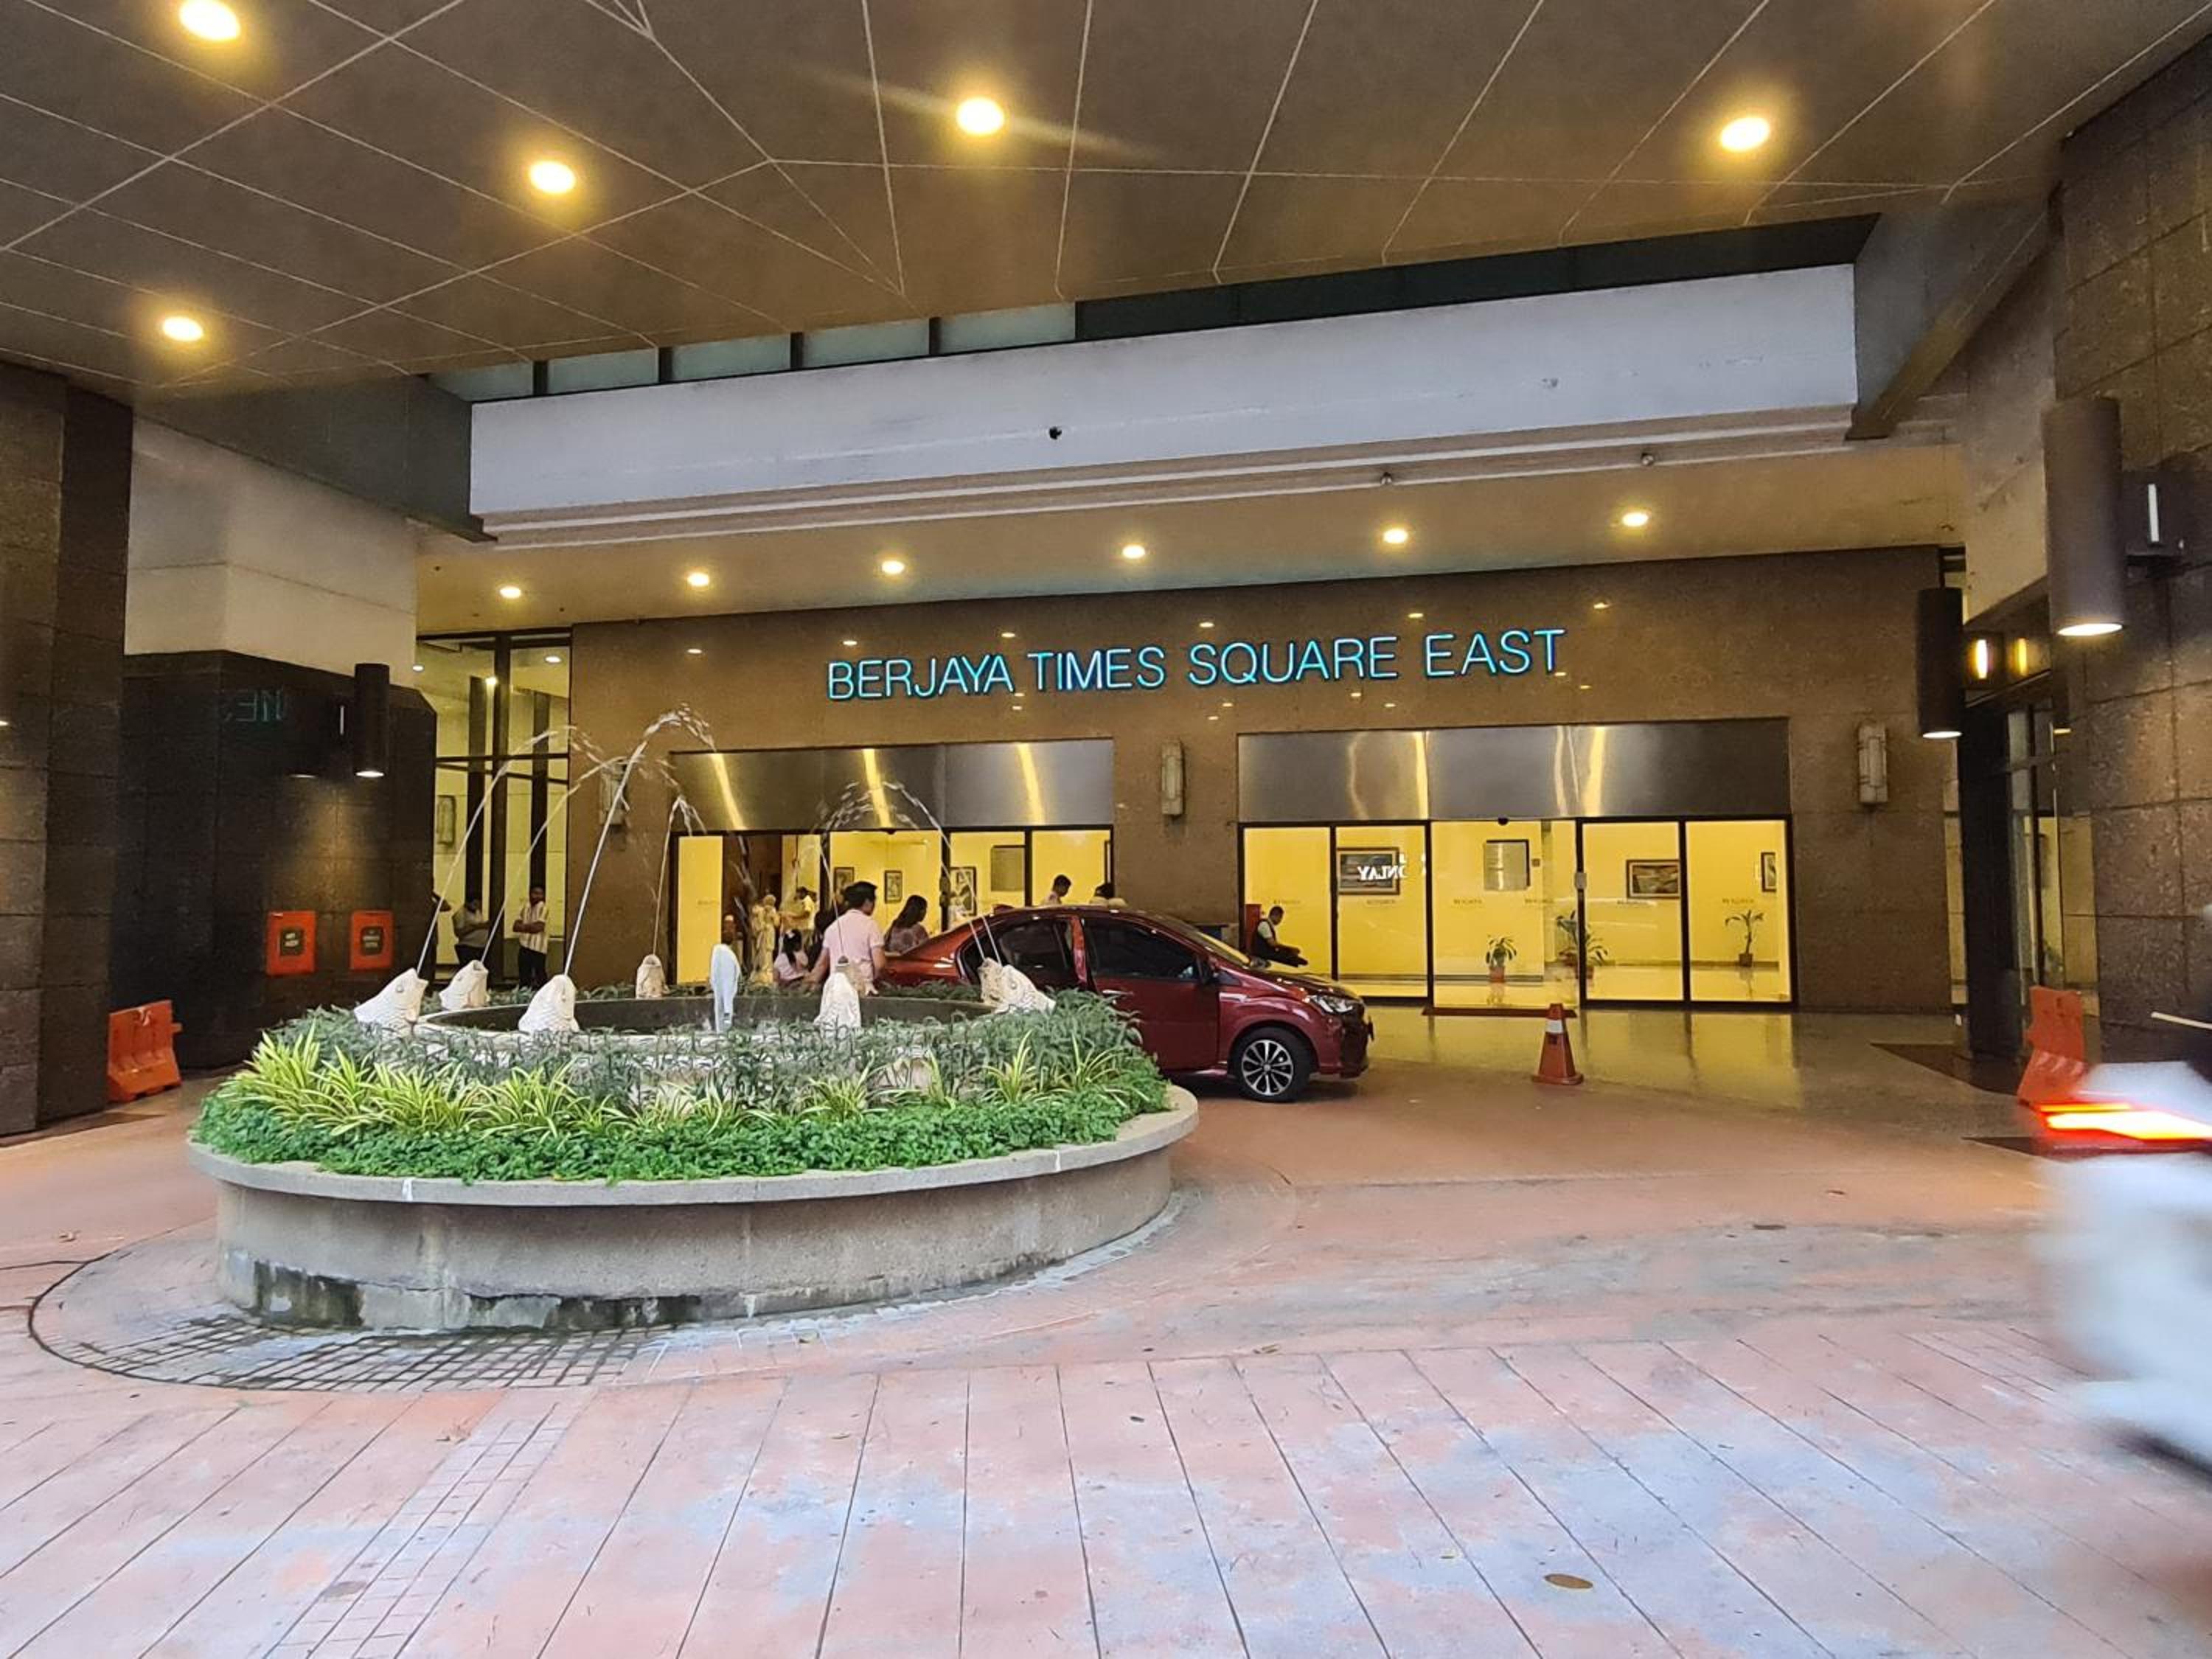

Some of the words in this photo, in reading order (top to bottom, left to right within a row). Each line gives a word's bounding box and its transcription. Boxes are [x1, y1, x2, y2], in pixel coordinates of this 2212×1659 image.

[827, 654, 1015, 700] BERJAYA
[1027, 646, 1166, 691] TIMES
[1187, 636, 1399, 686] SQUARE
[1424, 628, 1566, 678] EAST
